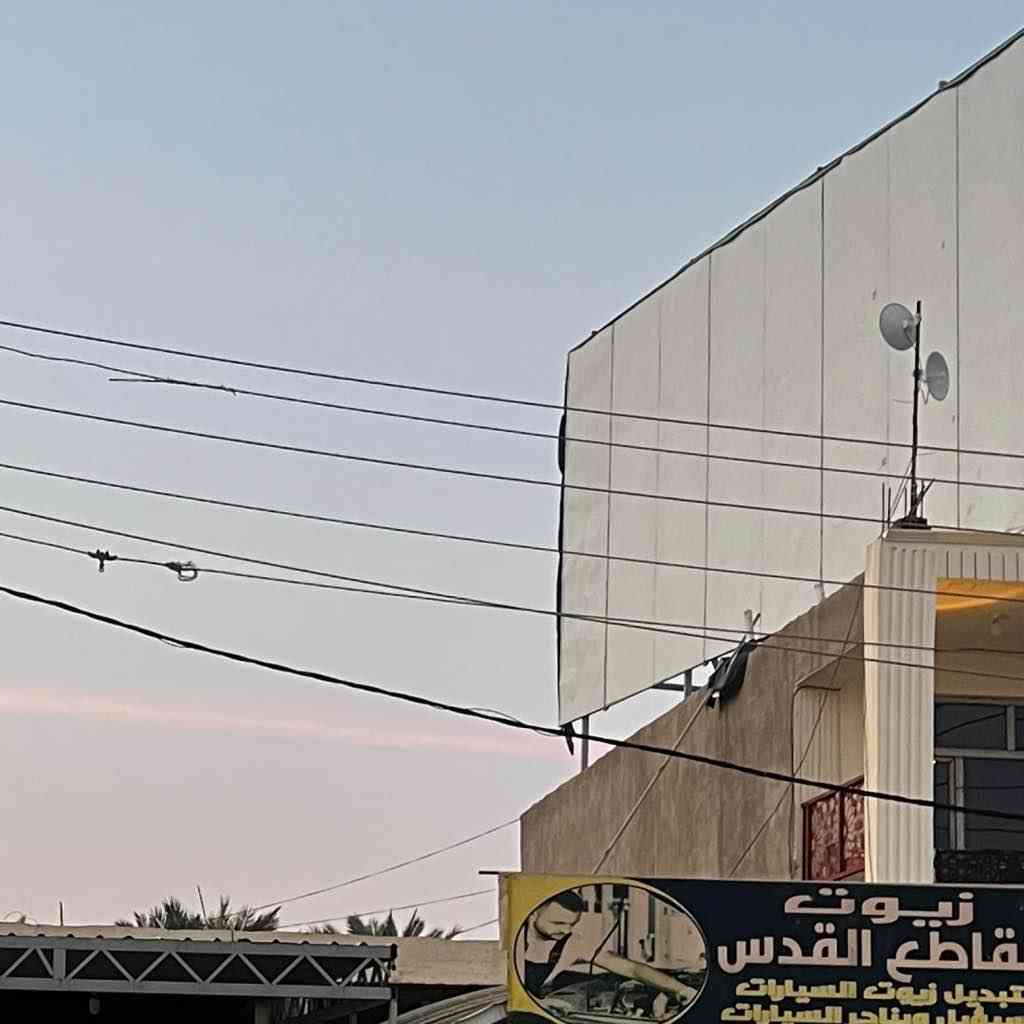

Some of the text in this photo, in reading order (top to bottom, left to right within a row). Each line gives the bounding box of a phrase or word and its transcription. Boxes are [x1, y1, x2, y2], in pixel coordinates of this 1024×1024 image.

[784, 887, 974, 927] زيوت
[717, 922, 1024, 983] قاطع القدس
[736, 978, 857, 1003] السيارات
[863, 981, 938, 1006] زيوت
